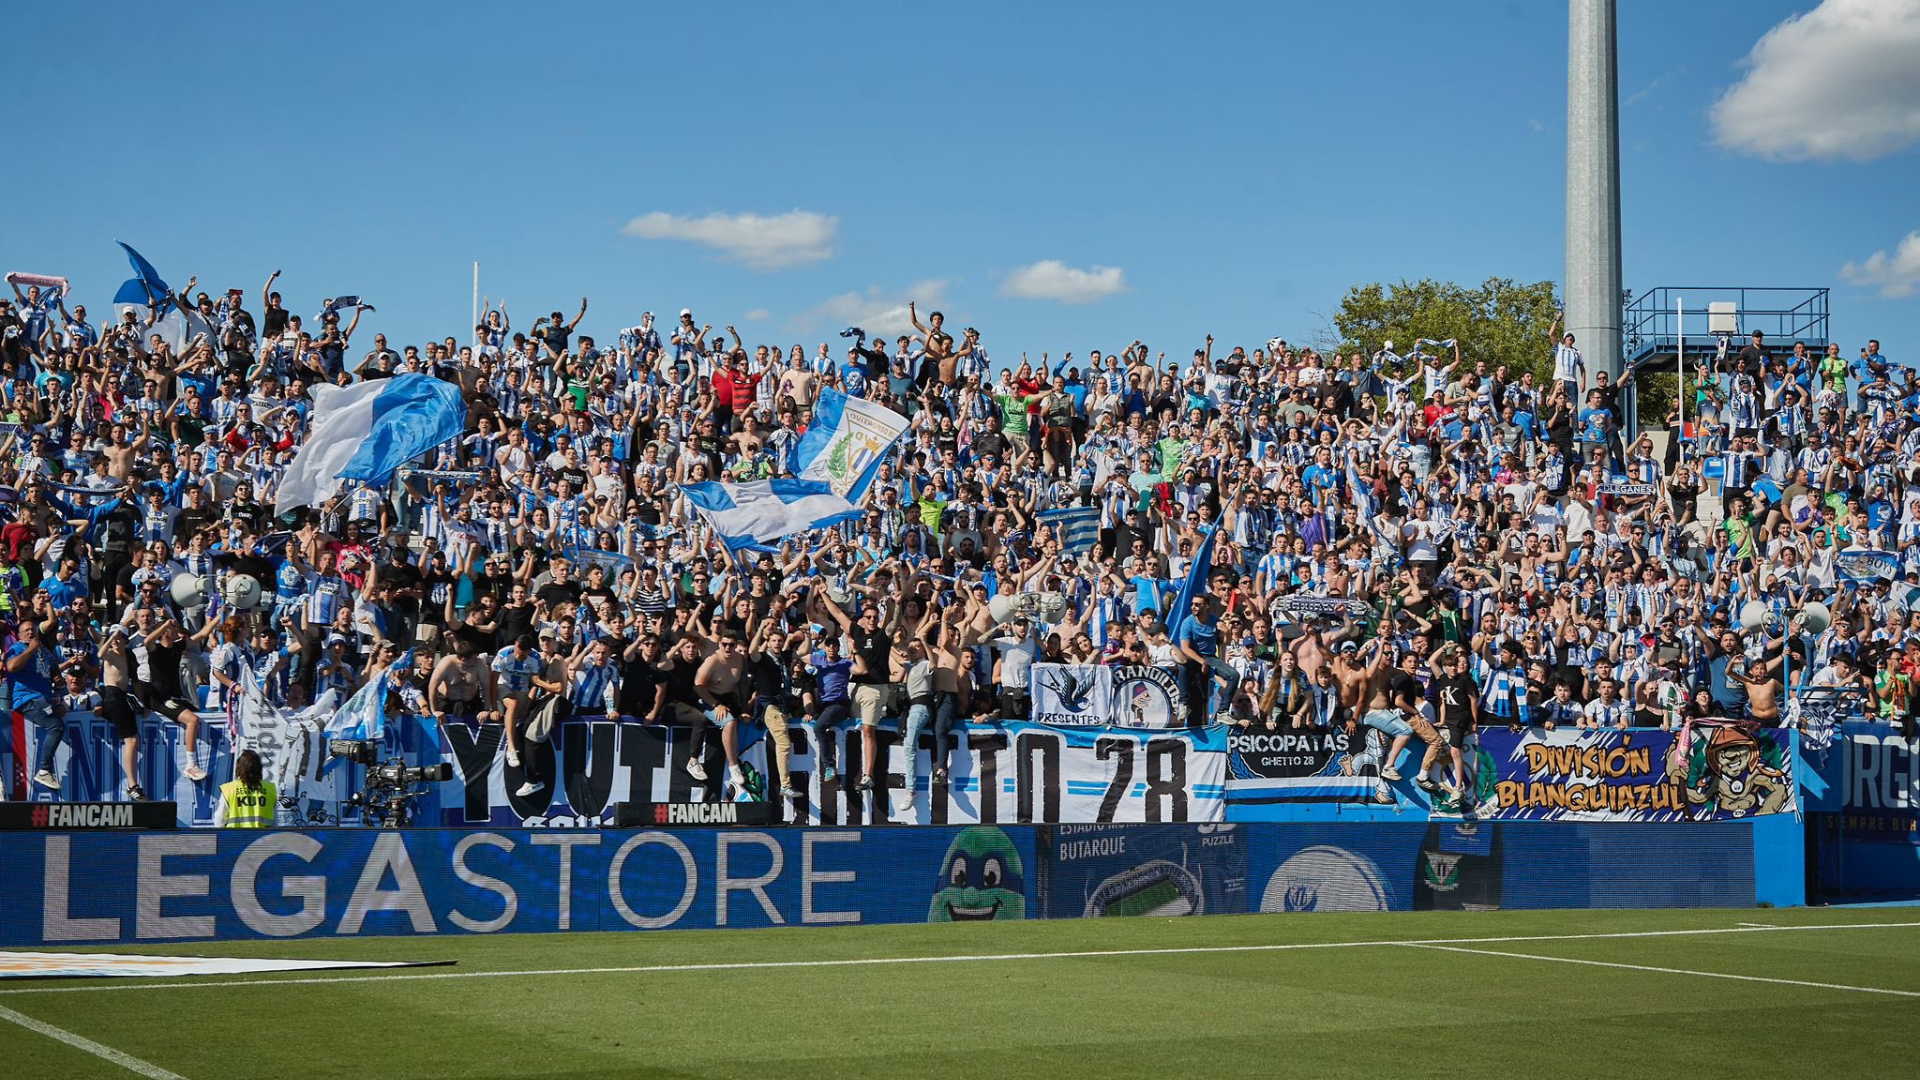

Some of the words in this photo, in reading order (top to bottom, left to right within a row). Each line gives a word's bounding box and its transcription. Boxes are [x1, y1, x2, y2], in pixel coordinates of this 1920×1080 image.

[1866, 557, 1893, 575] BOYS
[1290, 601, 1352, 611] LEGANS
[1038, 712, 1101, 725] PRESENTES
[1226, 734, 1350, 754] PSICOPATAS
[1261, 757, 1302, 767] GHETTO
[1303, 755, 1315, 766] 28
[1526, 735, 1650, 779] DIVISIÓN
[440, 722, 728, 823] YOUTH
[765, 732, 1061, 826] GHETTO
[1094, 734, 1188, 824] 28
[1495, 781, 1685, 812] BLANQUIAZUL
[31, 804, 134, 827] #FANCAM
[654, 802, 737, 823] #FANCAM
[1060, 836, 1126, 861] BUTARQUE
[1202, 834, 1235, 846] PUZZLE
